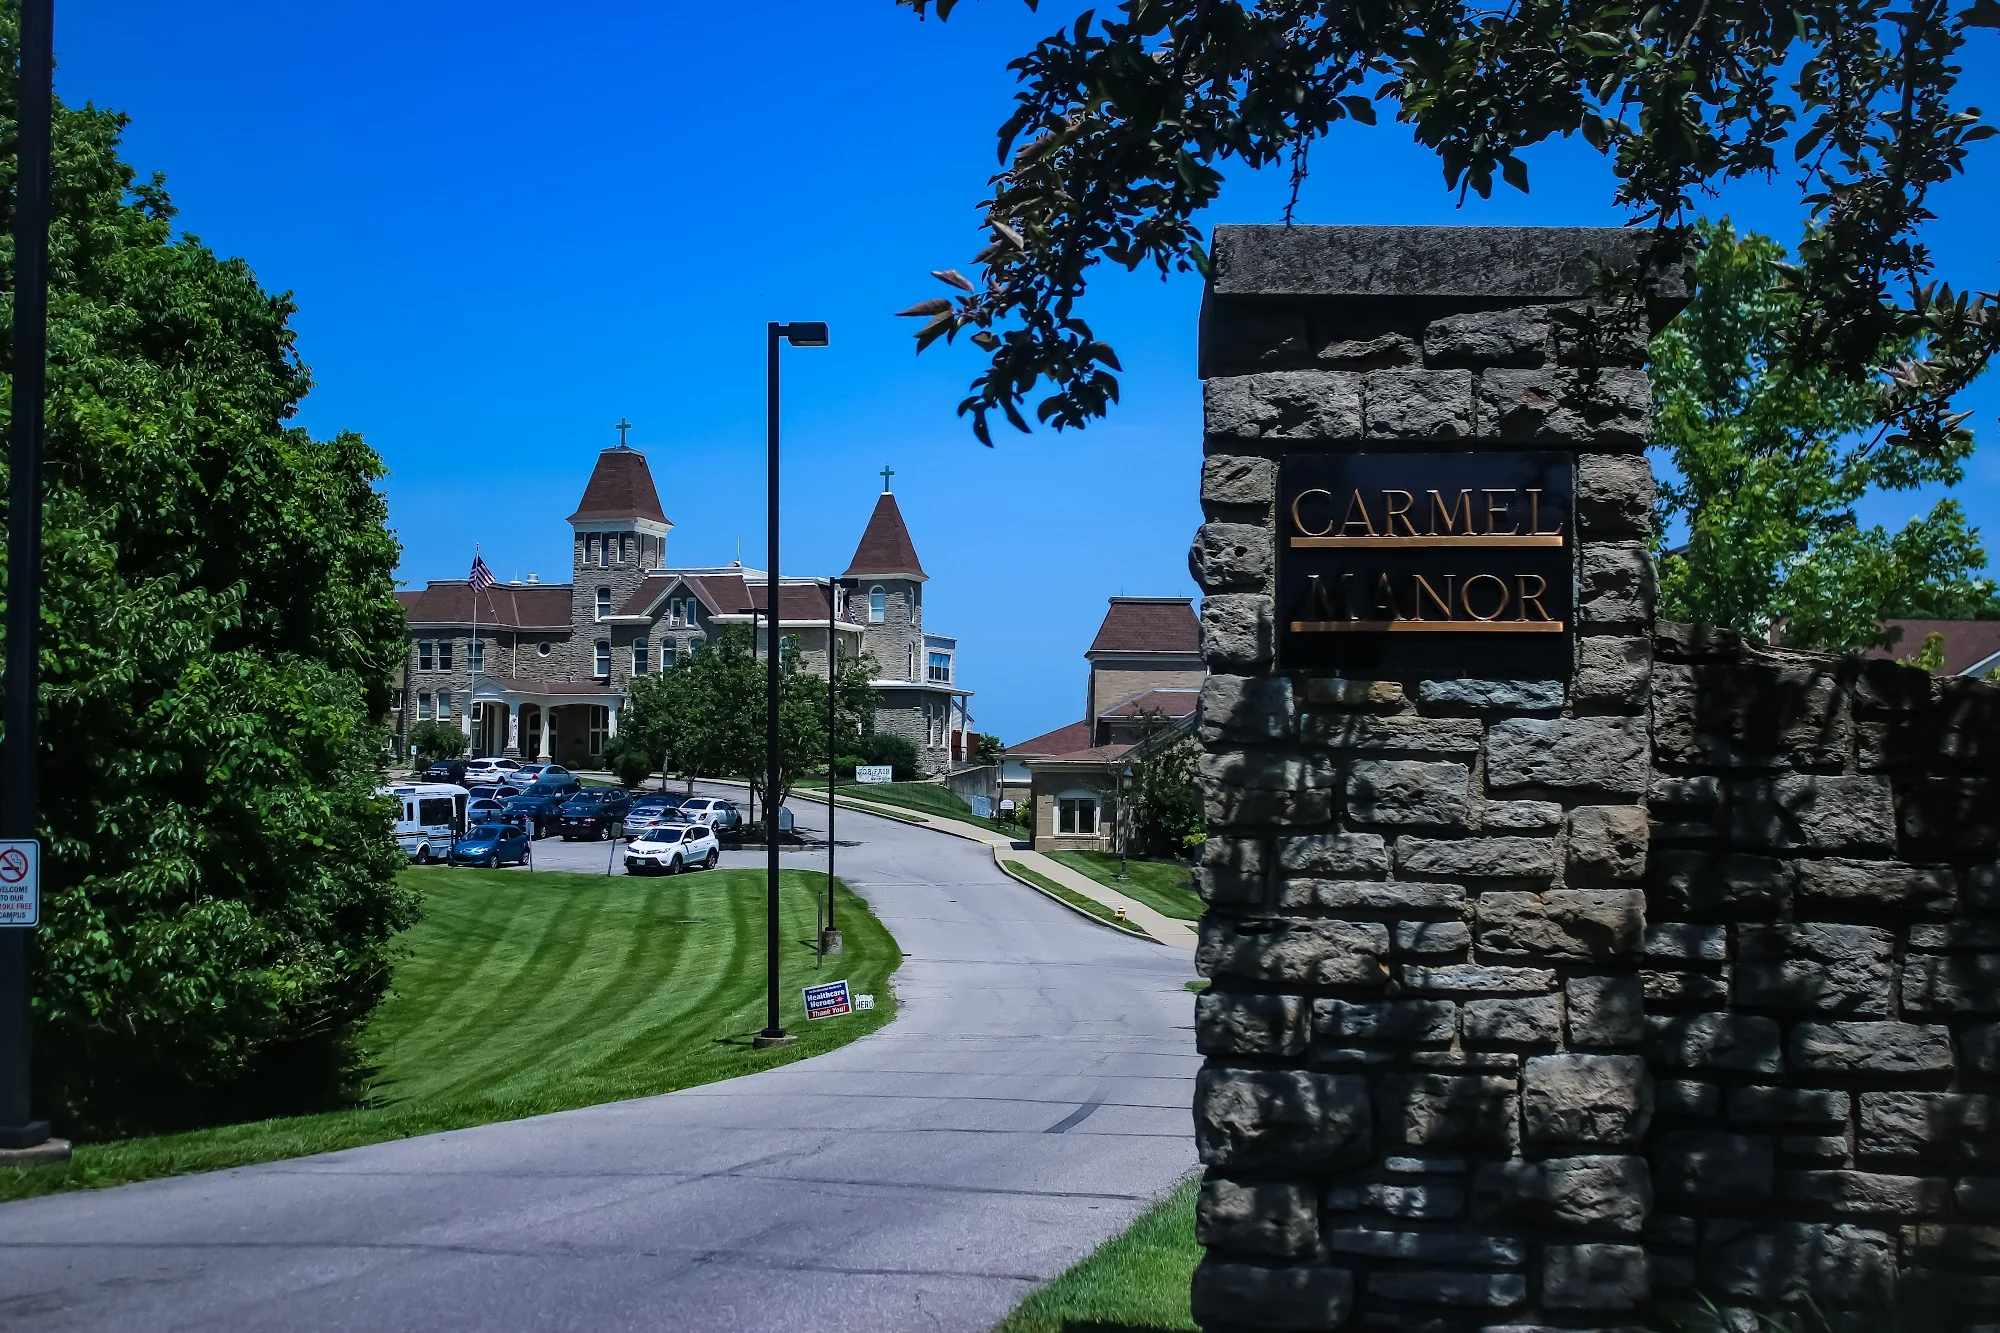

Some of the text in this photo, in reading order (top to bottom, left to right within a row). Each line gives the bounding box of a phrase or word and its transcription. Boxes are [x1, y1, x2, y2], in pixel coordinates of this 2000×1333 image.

[1291, 488, 1563, 536] CARMEL
[1307, 572, 1555, 622] MANOR
[807, 989, 845, 1002] Healthcare
[810, 998, 835, 1008] Heroes
[812, 1005, 846, 1018] Thank You!
